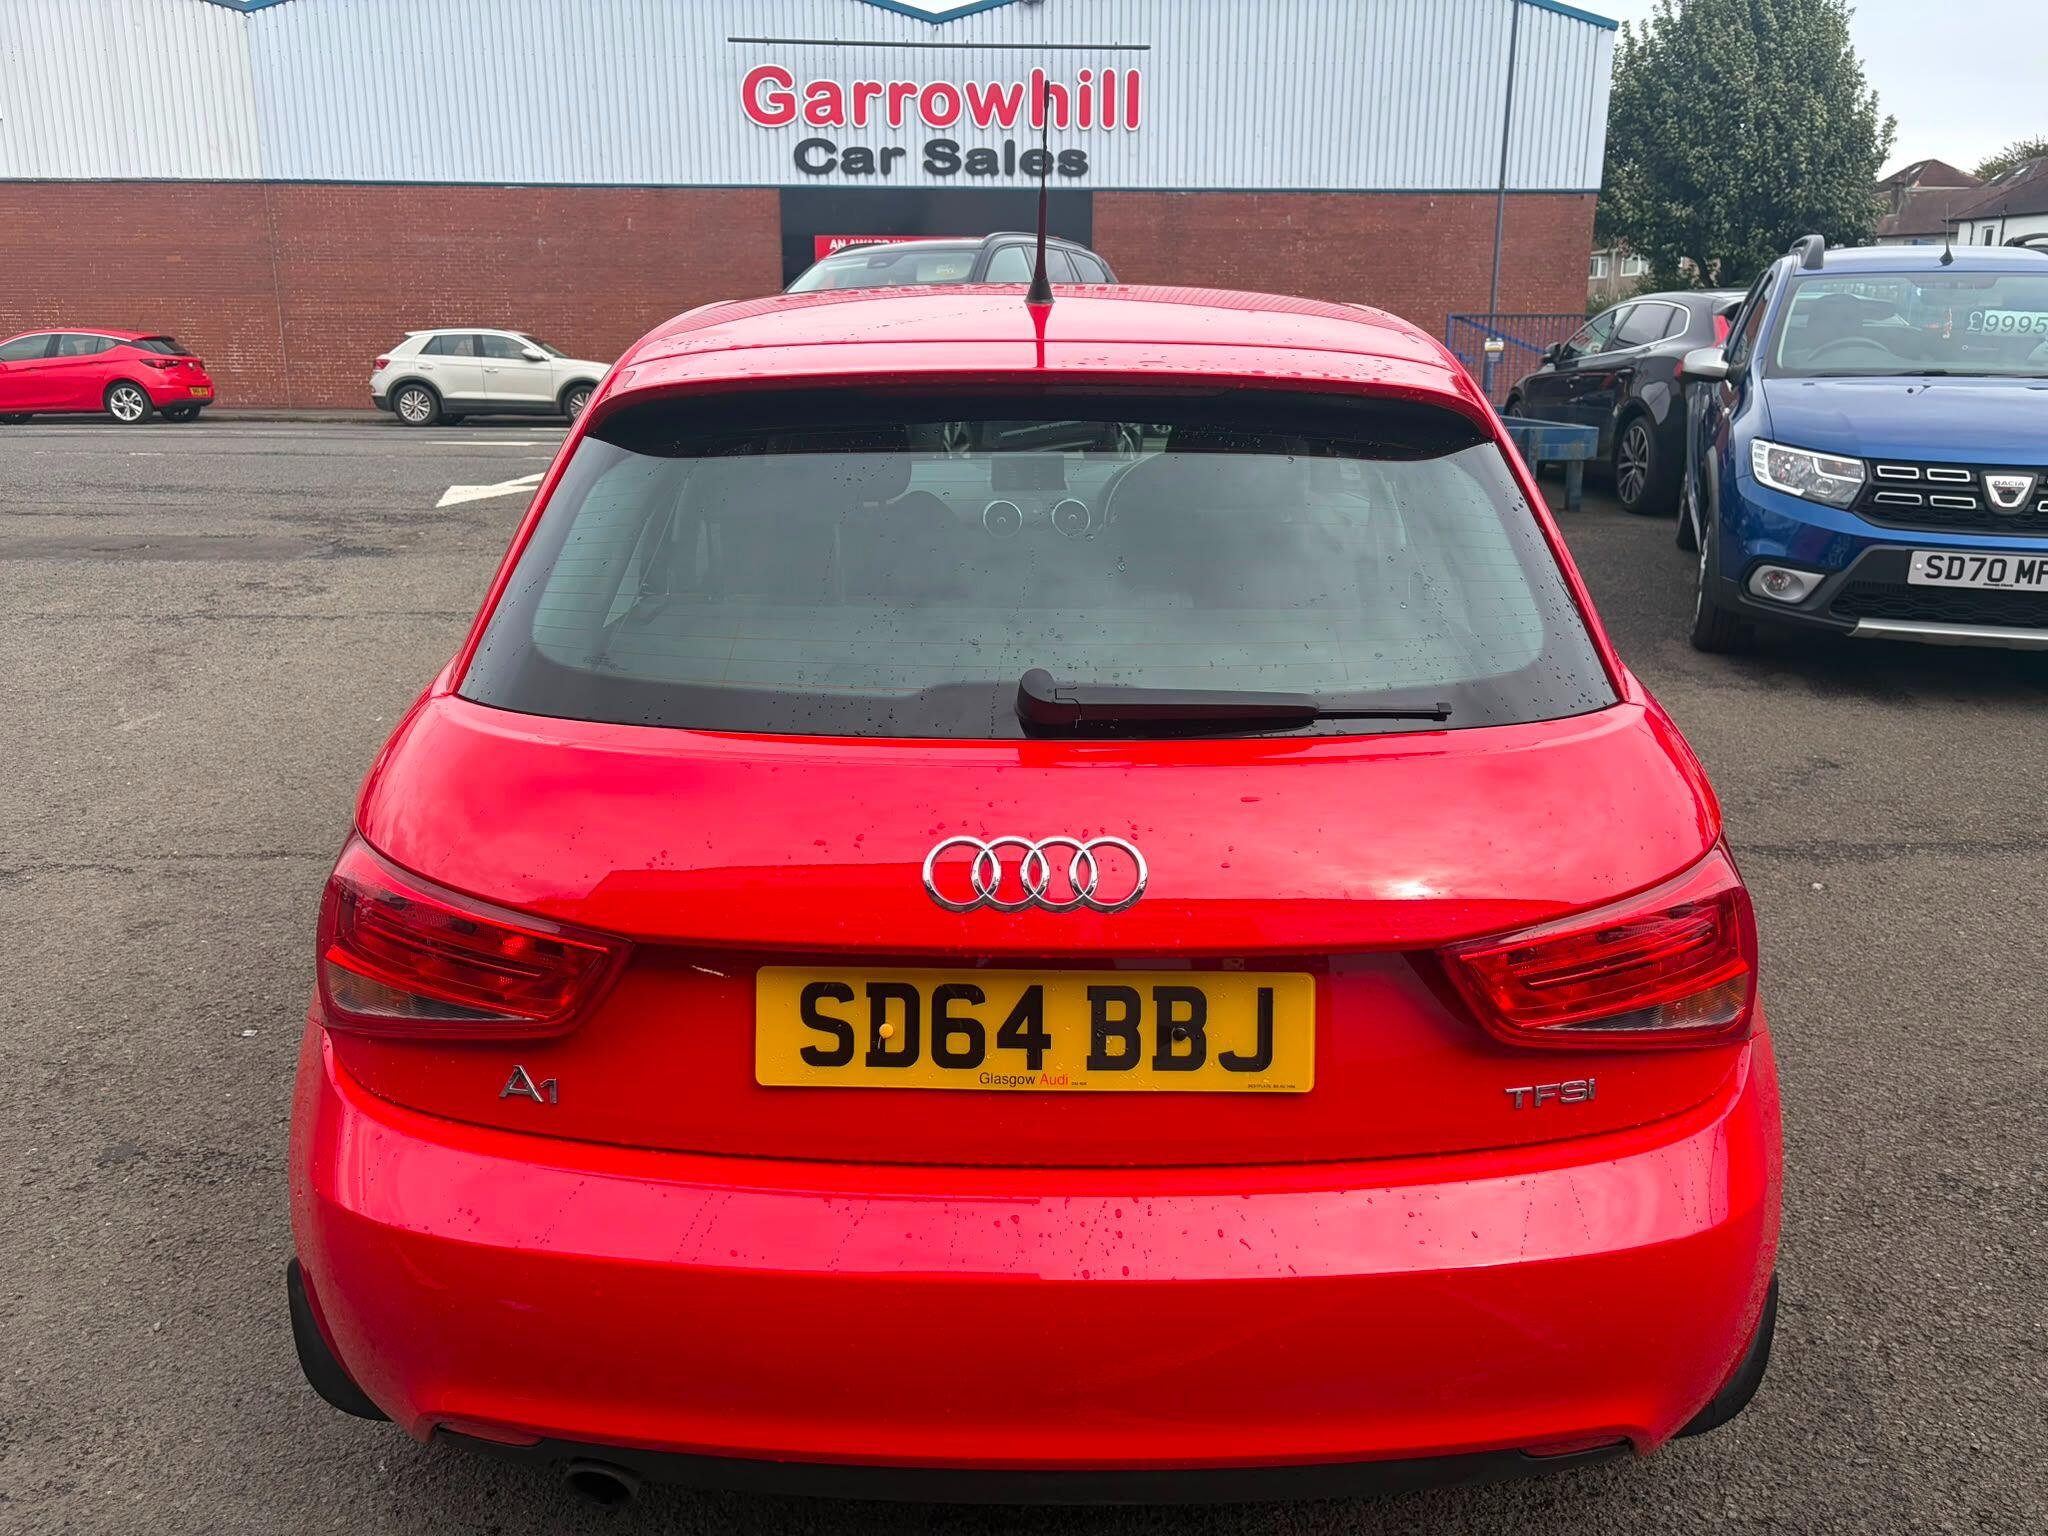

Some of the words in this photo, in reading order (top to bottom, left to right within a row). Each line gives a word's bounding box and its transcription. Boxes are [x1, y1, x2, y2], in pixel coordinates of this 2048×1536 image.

[741, 65, 1141, 131] Garrowhill
[794, 137, 906, 176] Car
[923, 138, 1089, 177] Sales
[1924, 555, 2008, 582] SD70
[800, 981, 1052, 1071] SD64
[1086, 985, 1275, 1073] BBJ
[499, 1064, 558, 1104] A1
[979, 1072, 1036, 1088] Glasgow
[1040, 1073, 1069, 1086] Audi
[1504, 1078, 1596, 1109] TFSI
